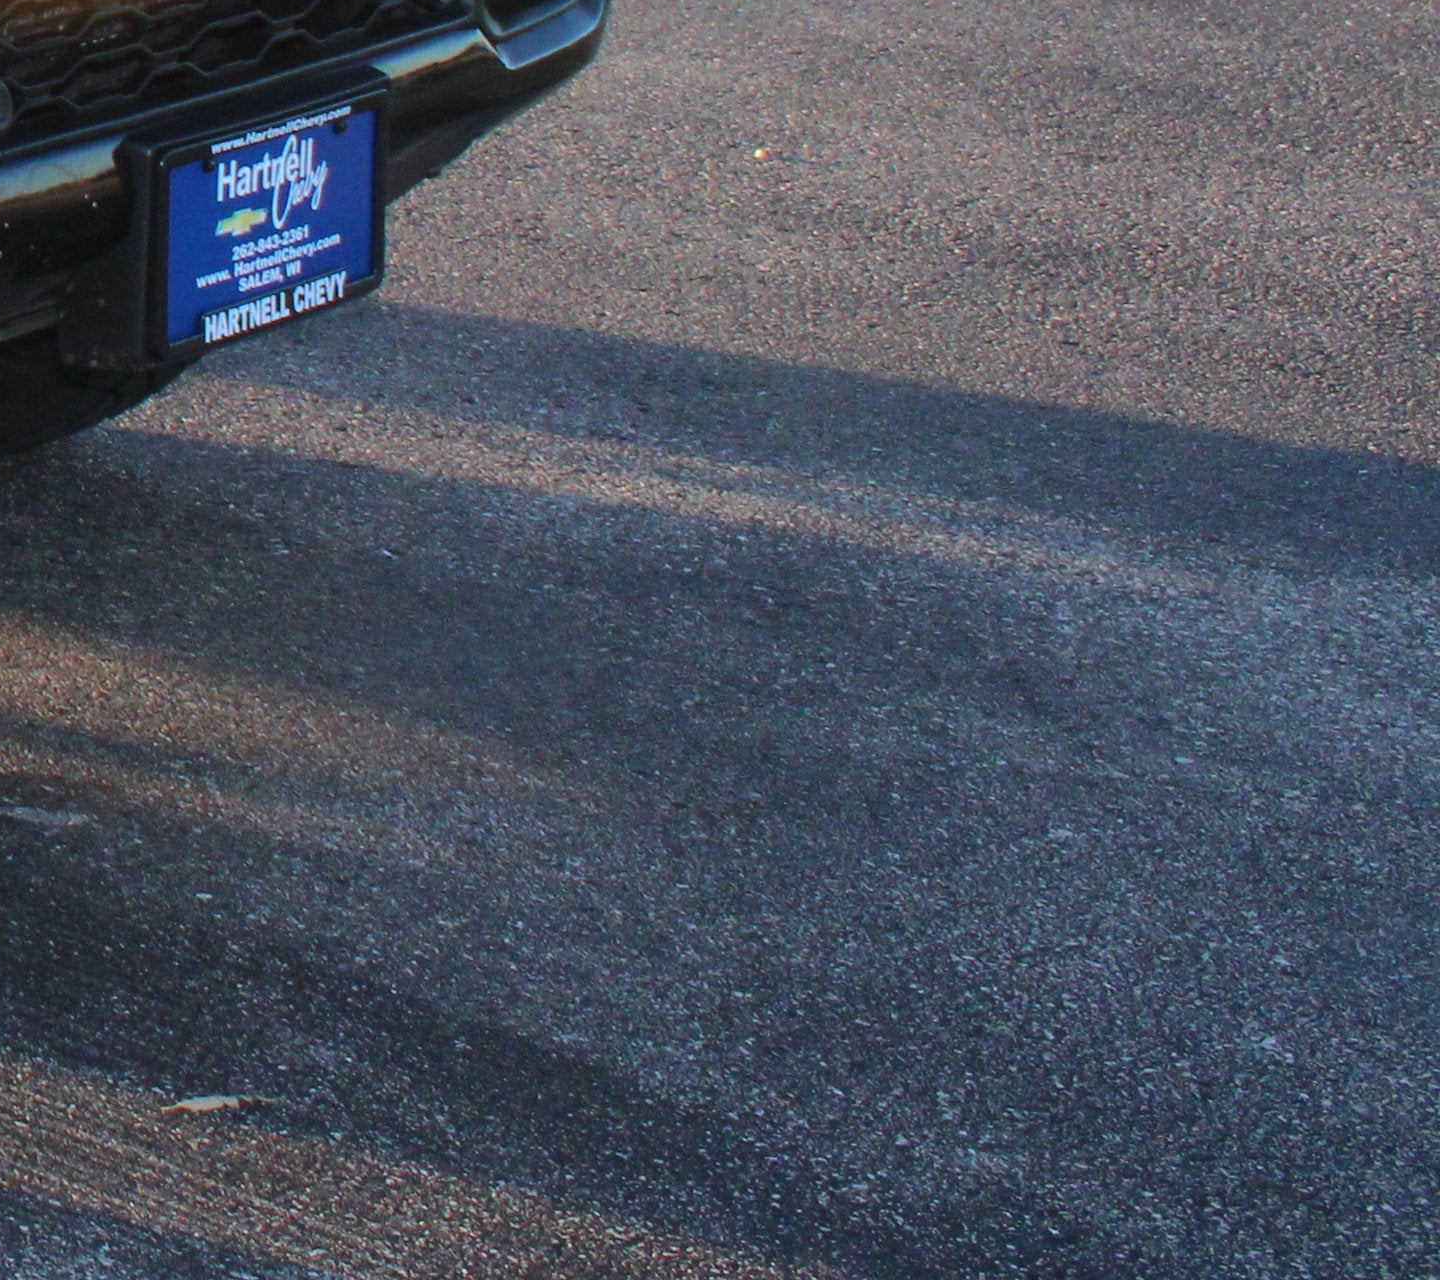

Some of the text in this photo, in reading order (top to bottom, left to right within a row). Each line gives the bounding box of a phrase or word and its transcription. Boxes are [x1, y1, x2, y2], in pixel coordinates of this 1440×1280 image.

[217, 137, 315, 202] Hartnell
[272, 134, 328, 230] Chevy
[231, 224, 309, 261] 262-843-2361
[285, 260, 301, 278] WI
[204, 271, 347, 343] HARTNELL CHEVY
